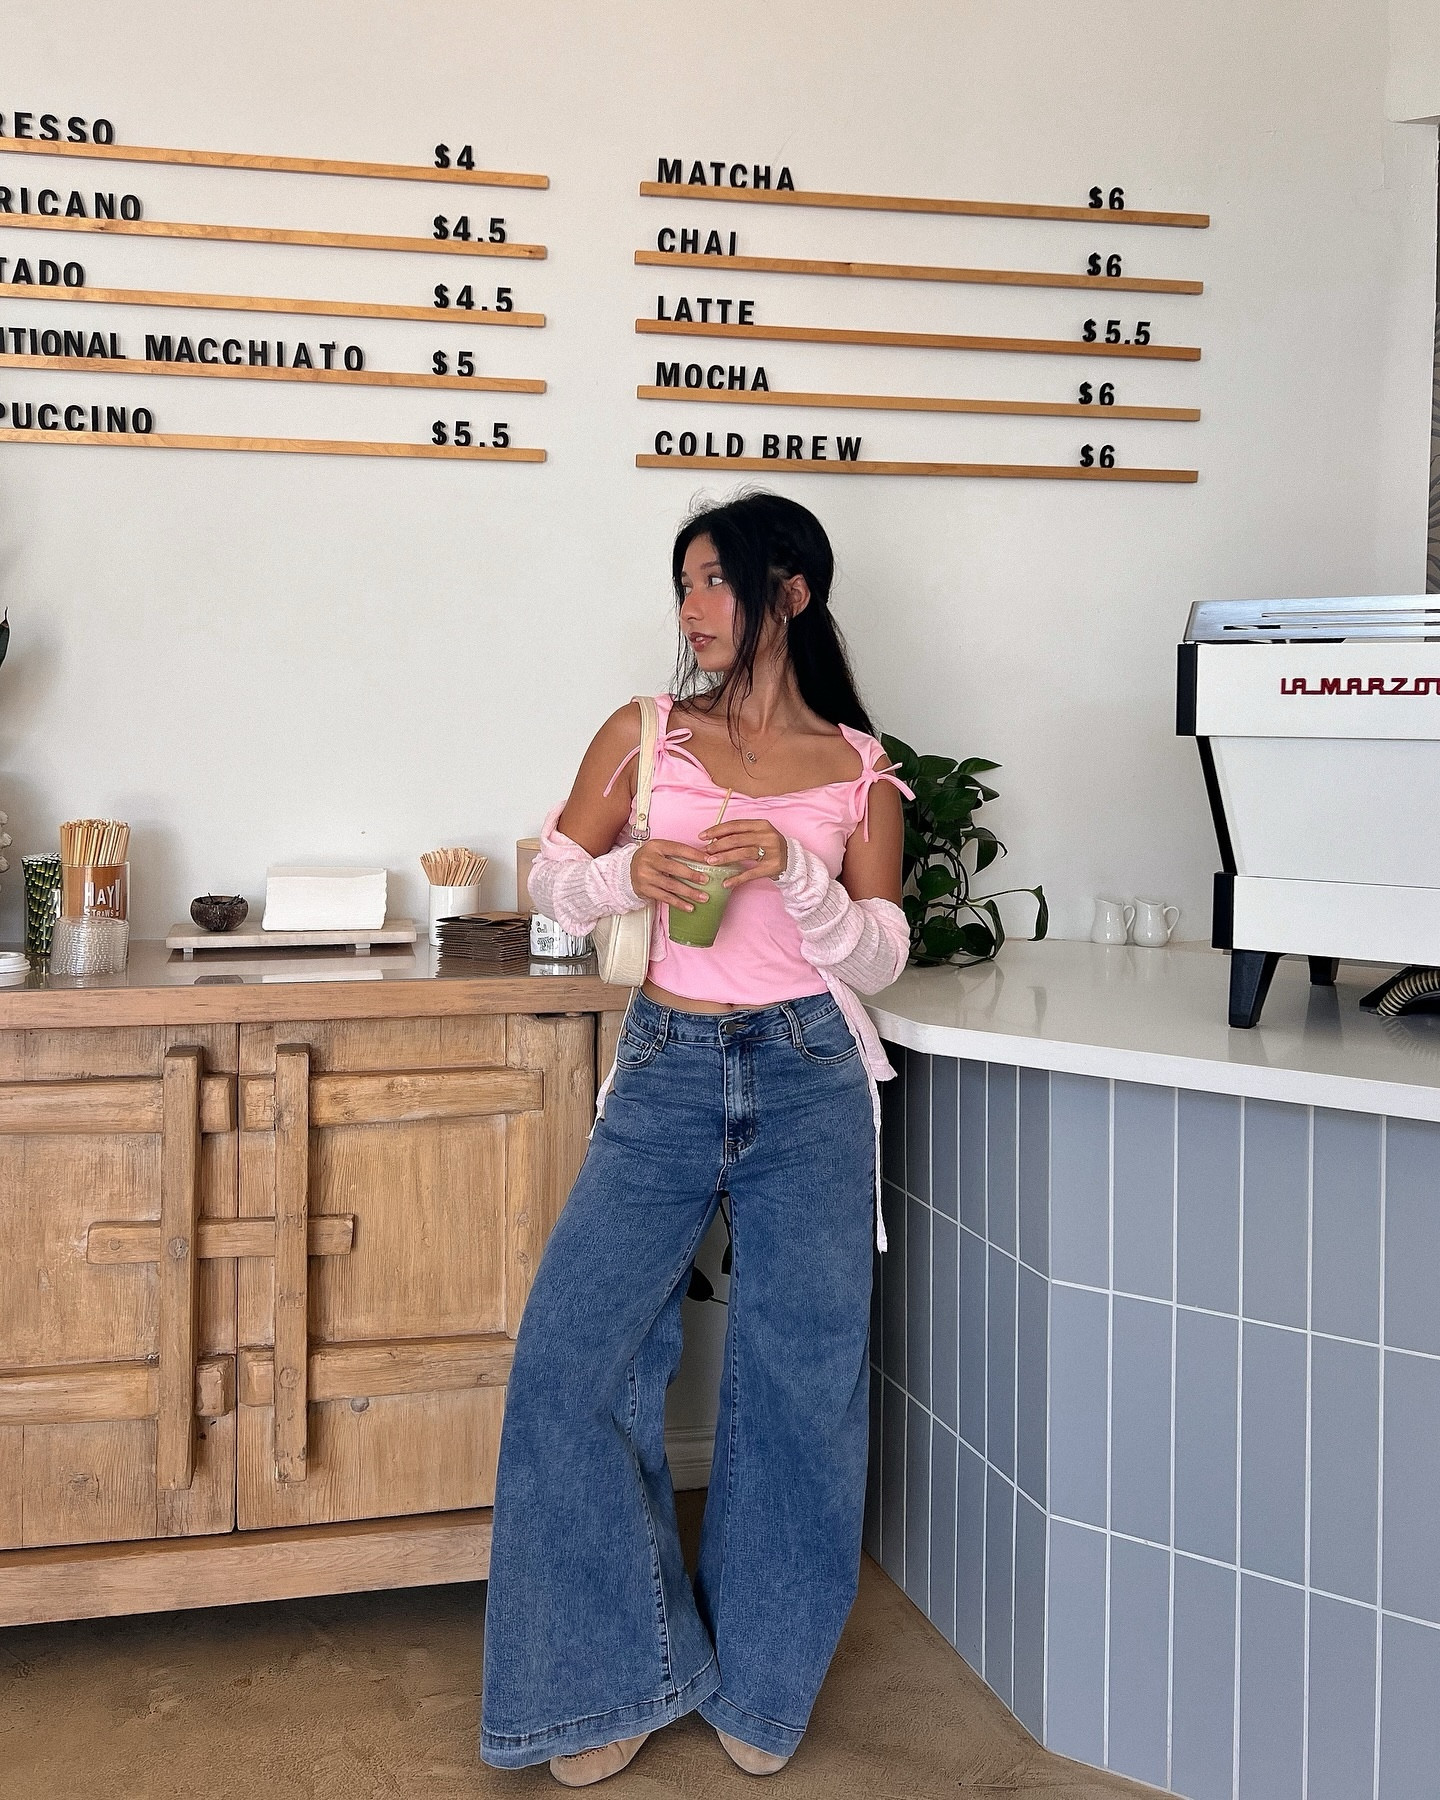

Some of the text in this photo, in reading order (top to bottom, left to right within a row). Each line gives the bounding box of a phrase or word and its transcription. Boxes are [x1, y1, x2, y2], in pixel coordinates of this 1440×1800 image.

[0, 112, 475, 171] ESSO $4
[657, 158, 1125, 211] MATCHA $6
[0, 186, 506, 243] RICANO $4.5
[657, 228, 1122, 278] CHAI $6
[433, 283, 513, 312] $4.5
[657, 296, 1151, 346] LATTE $5.5
[0, 327, 474, 377] ITIONAL MACCHIATO $5
[655, 362, 1115, 407] MOCHA $6
[0, 402, 510, 448] UCCINO $5.5
[654, 430, 1115, 469] COLD BREW $6
[1281, 677, 1440, 696] LA MARZO
[83, 906, 115, 918] STRAWS
[84, 879, 121, 917] HAY!
